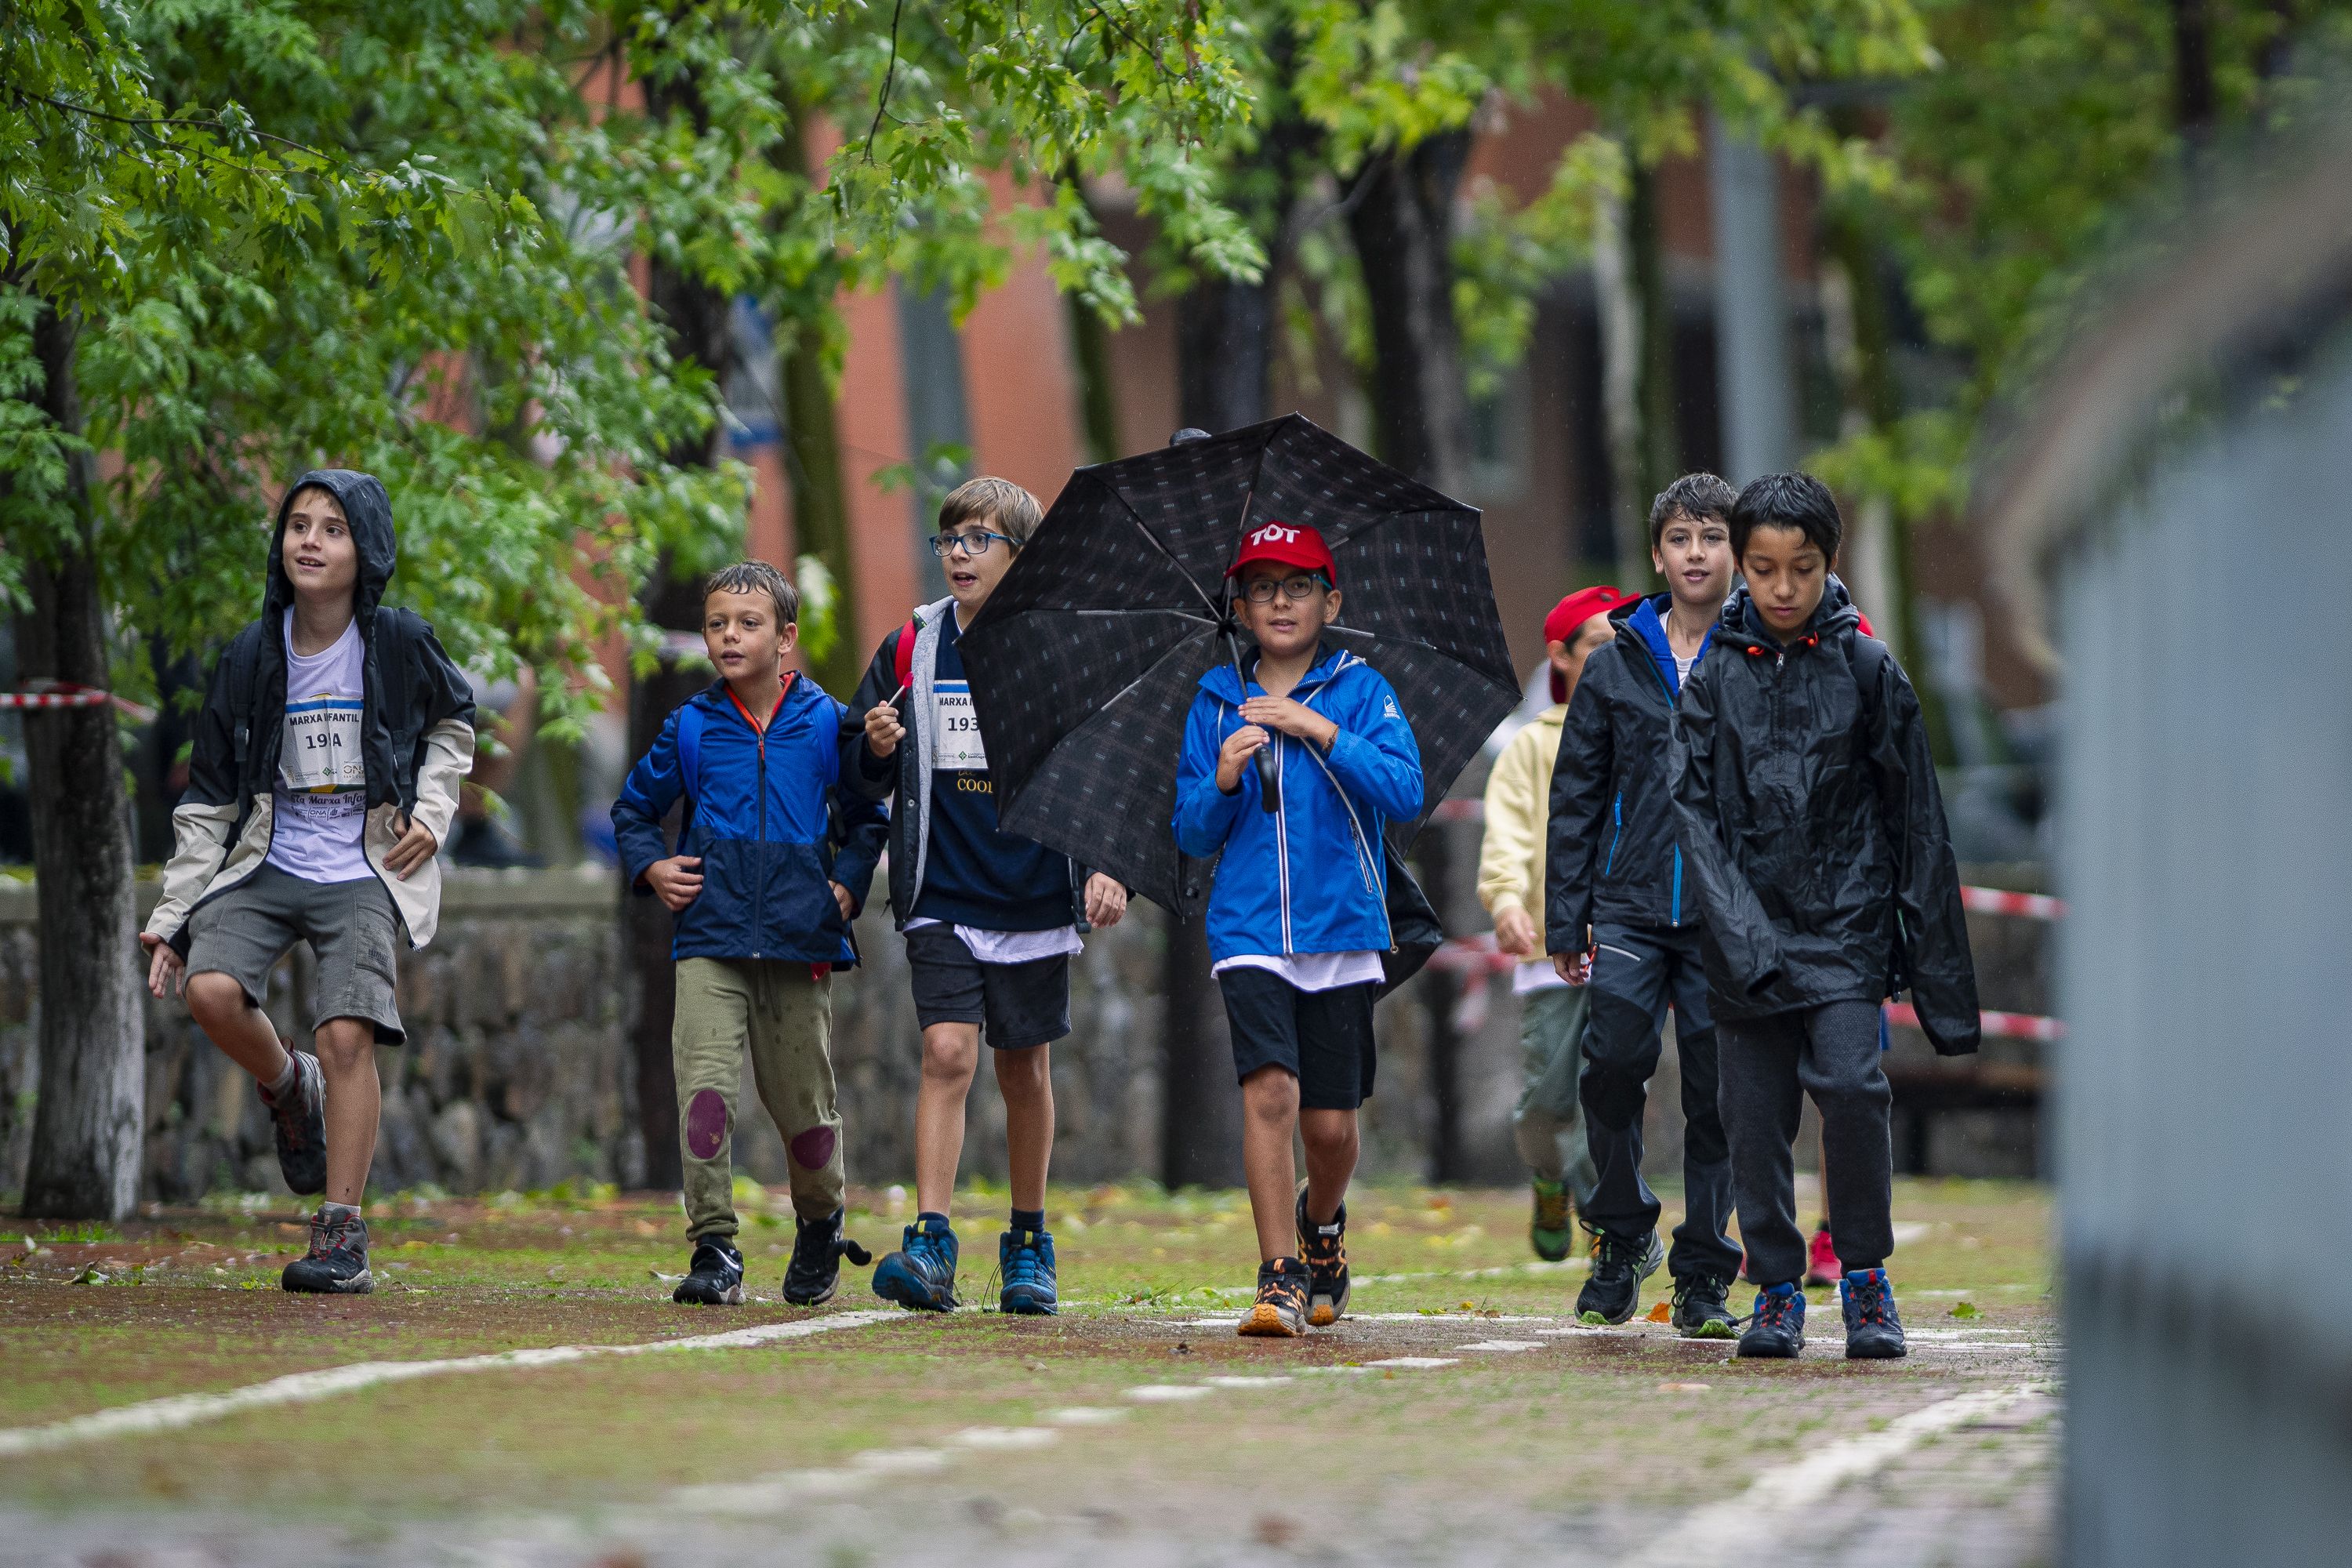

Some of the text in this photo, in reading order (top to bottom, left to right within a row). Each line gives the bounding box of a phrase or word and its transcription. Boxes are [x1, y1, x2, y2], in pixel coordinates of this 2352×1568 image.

[1250, 524, 1300, 546] TOT
[939, 697, 967, 706] MARXA
[289, 714, 323, 727] MARXA
[305, 732, 343, 750] 19A
[308, 795, 340, 804] Marxa
